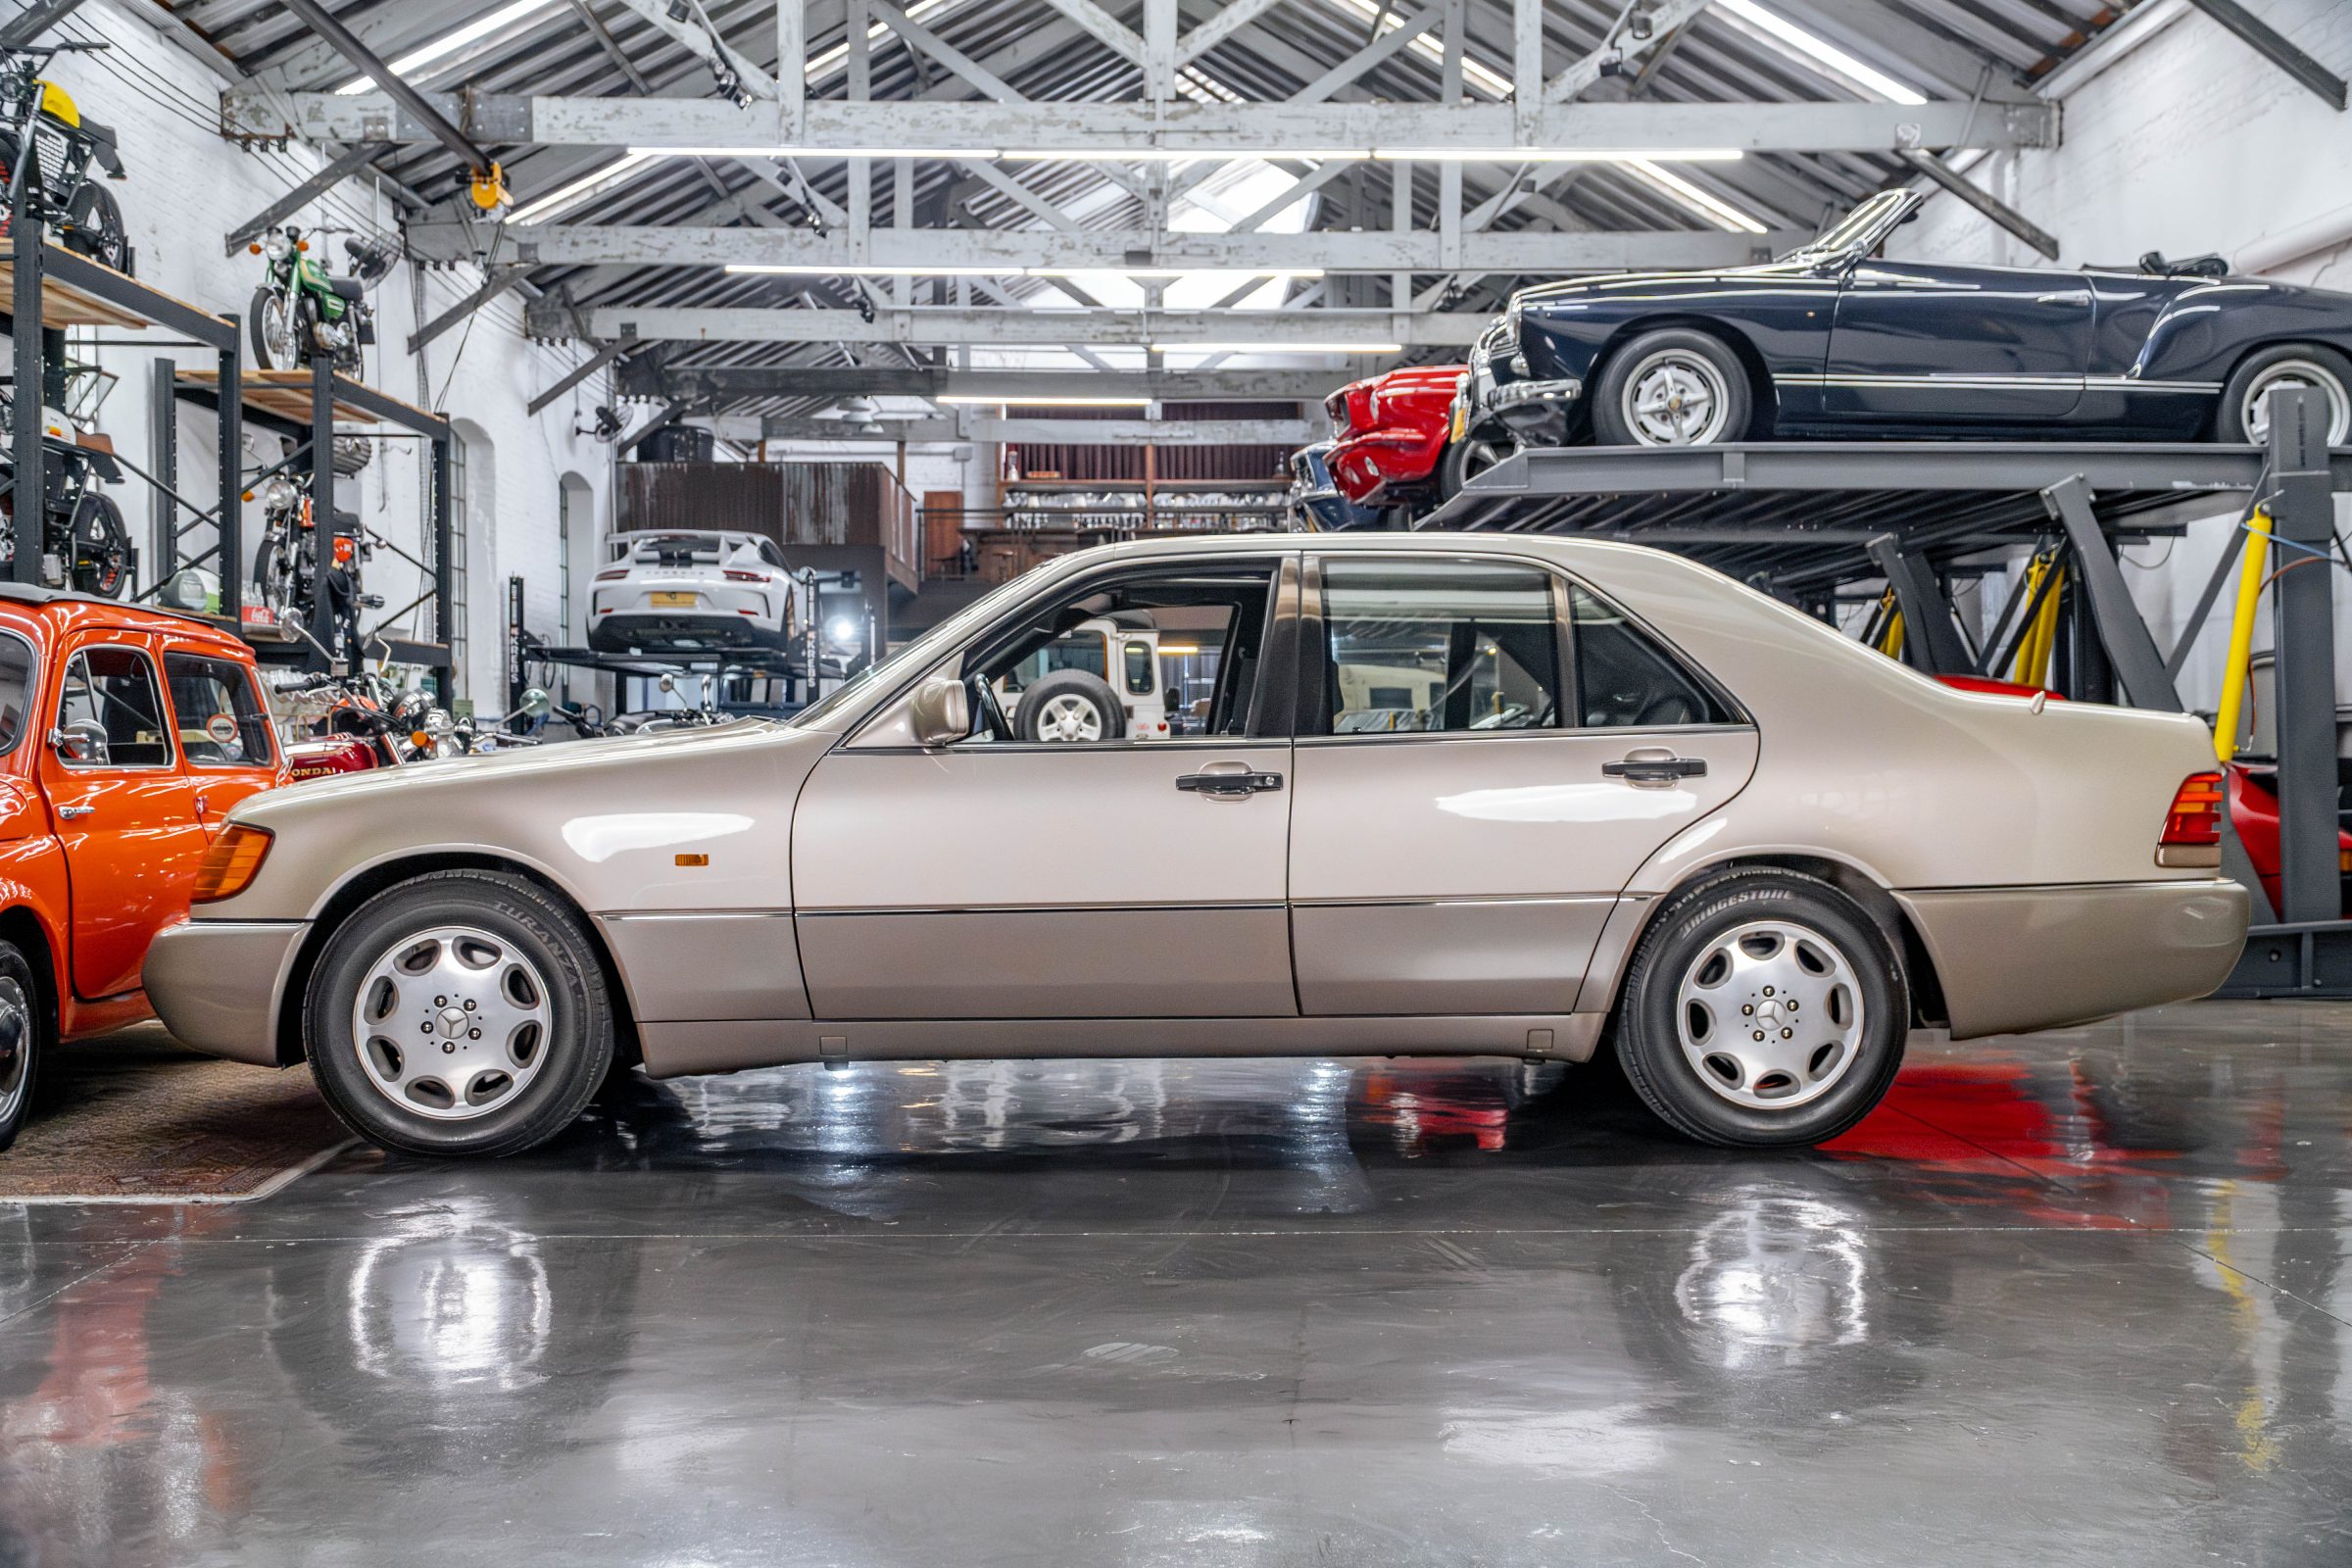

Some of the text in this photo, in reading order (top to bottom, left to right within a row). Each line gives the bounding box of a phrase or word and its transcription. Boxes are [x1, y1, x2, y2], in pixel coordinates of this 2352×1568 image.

[291, 767, 332, 777] ONDA
[1680, 889, 1795, 940] BRIDGESTONE
[494, 901, 580, 988] TURANZA
